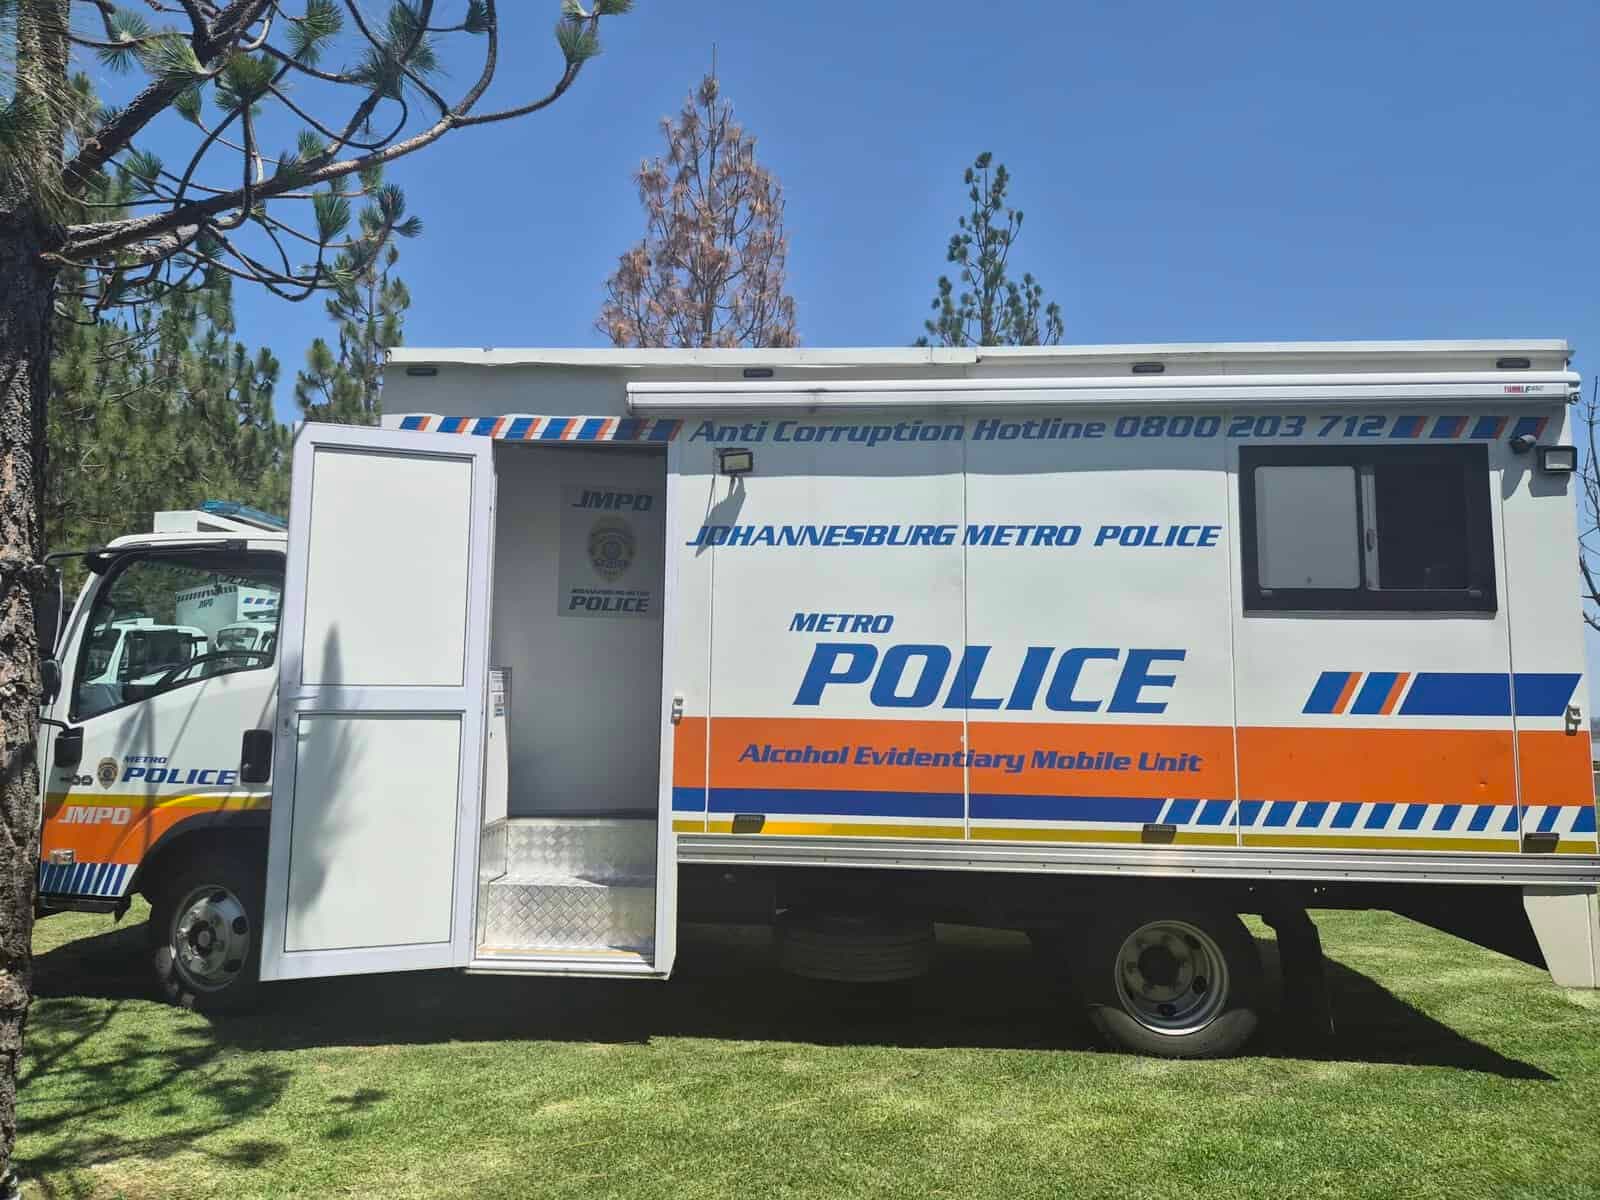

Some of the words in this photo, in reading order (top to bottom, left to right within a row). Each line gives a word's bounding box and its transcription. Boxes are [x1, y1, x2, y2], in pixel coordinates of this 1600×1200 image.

[688, 420, 768, 443] Anti
[773, 420, 964, 447] Corruption
[972, 418, 1106, 440] Hotline
[1113, 415, 1221, 438] 0800
[1227, 415, 1307, 438] 203
[1317, 415, 1387, 438] 712
[685, 525, 958, 546] JOHANNESBURG
[962, 525, 1082, 547] METRO
[1093, 525, 1222, 547] POLICE
[568, 595, 650, 612] POLICE
[789, 613, 895, 633] METRO
[792, 642, 1187, 714] POLICE
[122, 755, 168, 765] METRO
[738, 743, 849, 765] Alcohol
[853, 746, 1025, 774] Evidentiary
[1030, 750, 1132, 772] Mobile
[1137, 751, 1203, 772] Unit
[121, 767, 239, 785] POLICE
[58, 806, 131, 825] JMPD
